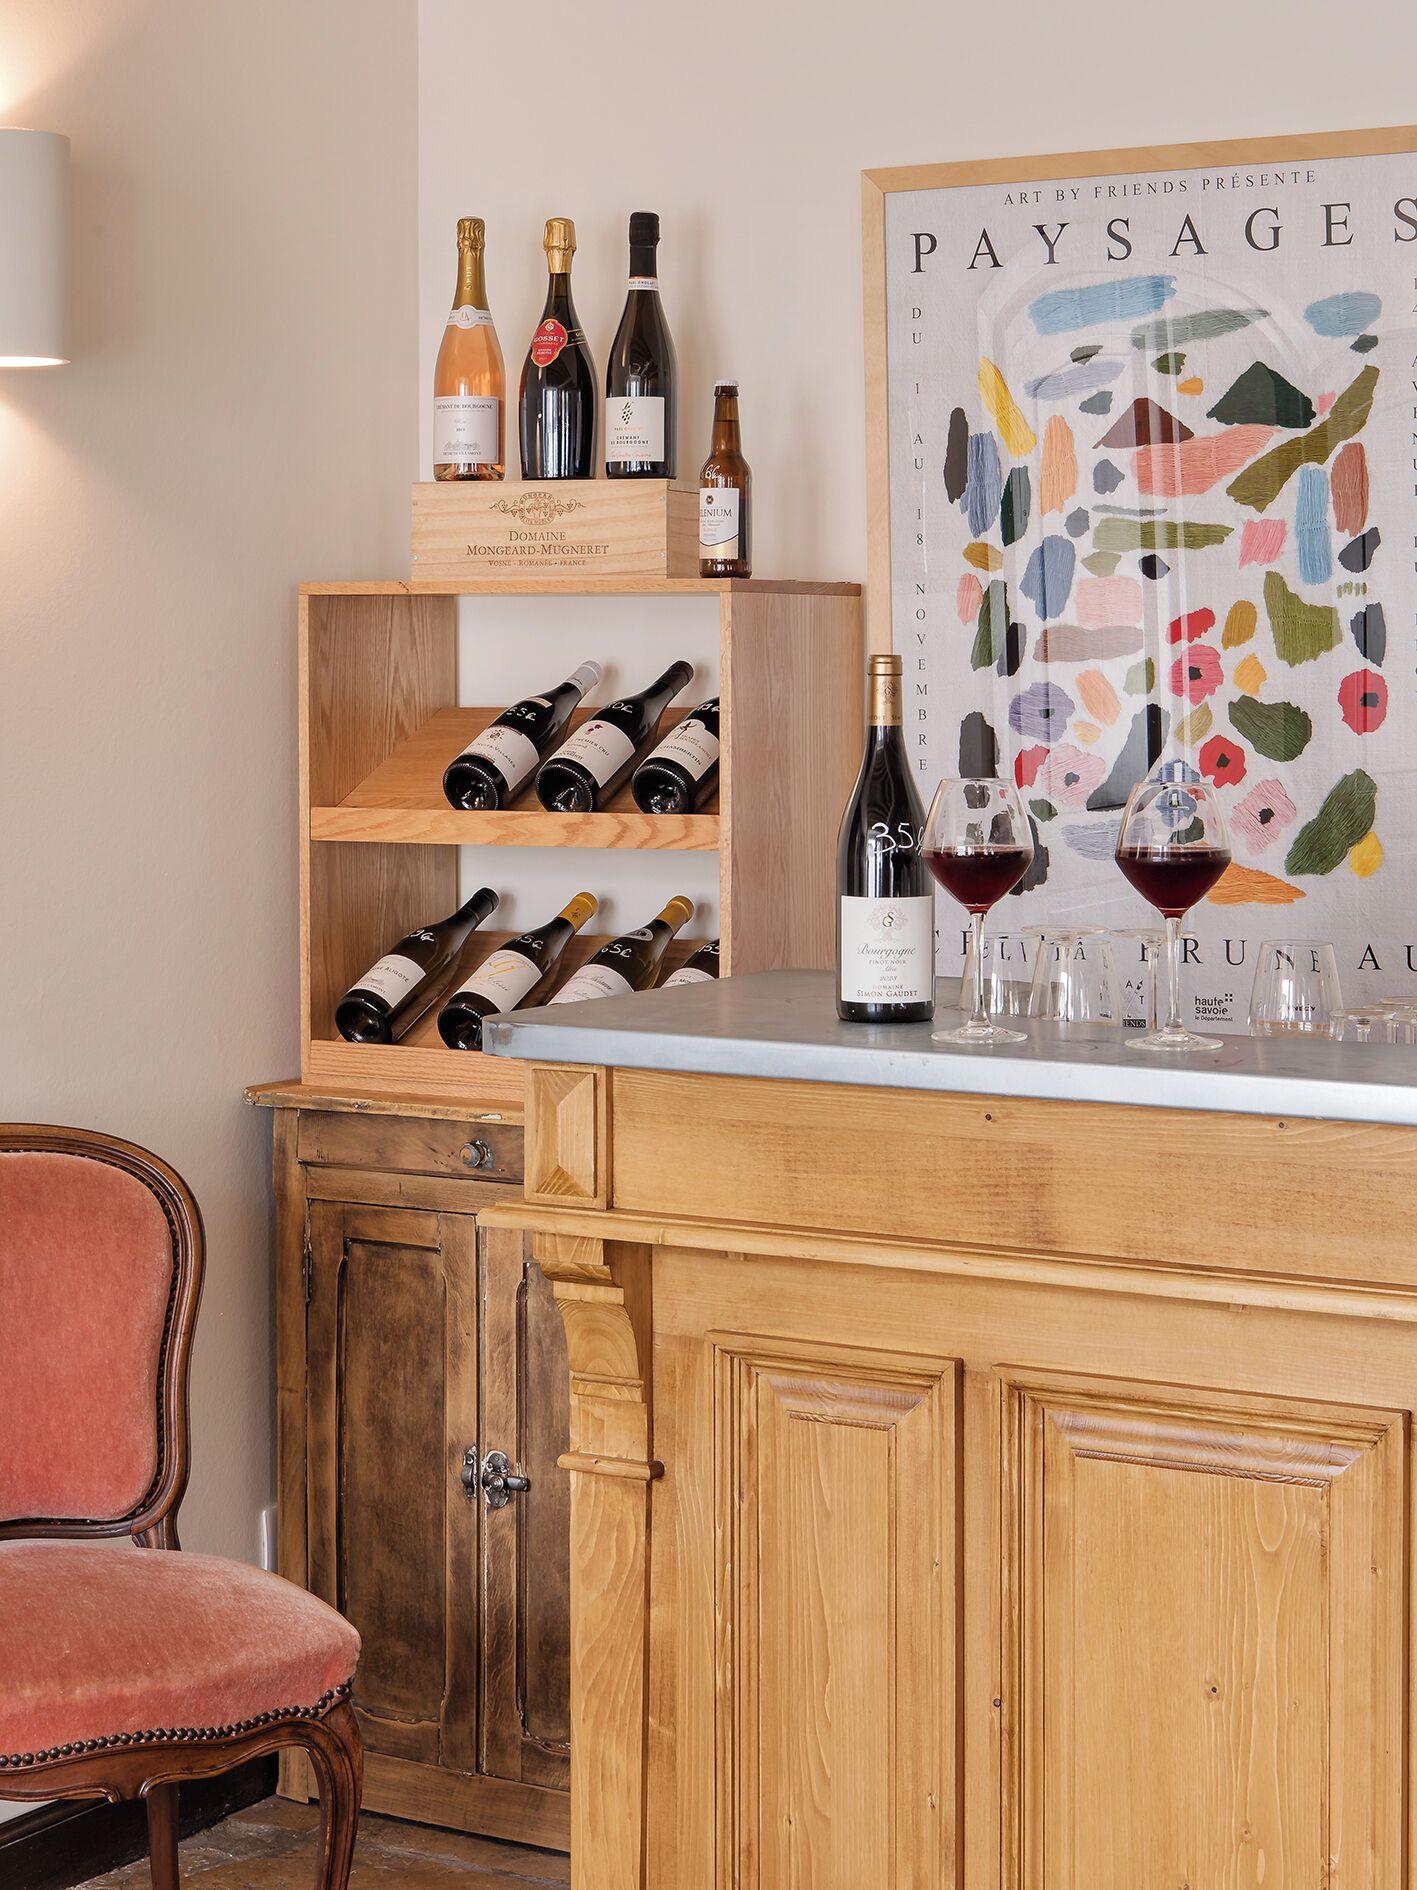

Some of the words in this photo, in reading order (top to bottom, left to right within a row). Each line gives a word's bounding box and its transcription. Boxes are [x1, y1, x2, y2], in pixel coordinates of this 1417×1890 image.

[1004, 191, 1042, 205] ART
[1055, 187, 1081, 202] BY
[1094, 180, 1188, 199] FRIENDS
[1202, 170, 1316, 191] PRÉSENTE
[910, 196, 1417, 274] PAYSAGES
[911, 307, 922, 345] DU
[913, 433, 924, 470] AU
[508, 530, 567, 542] DOMAINE
[466, 544, 609, 556] MONGEARD-MUGNERET
[915, 583, 928, 771] NOVEMBRE
[857, 944, 916, 959] Bourgogne
[857, 989, 883, 997] SIMON
[886, 990, 918, 998] GAUDET
[1194, 995, 1224, 1006] haute
[1195, 1007, 1228, 1015] savoie
